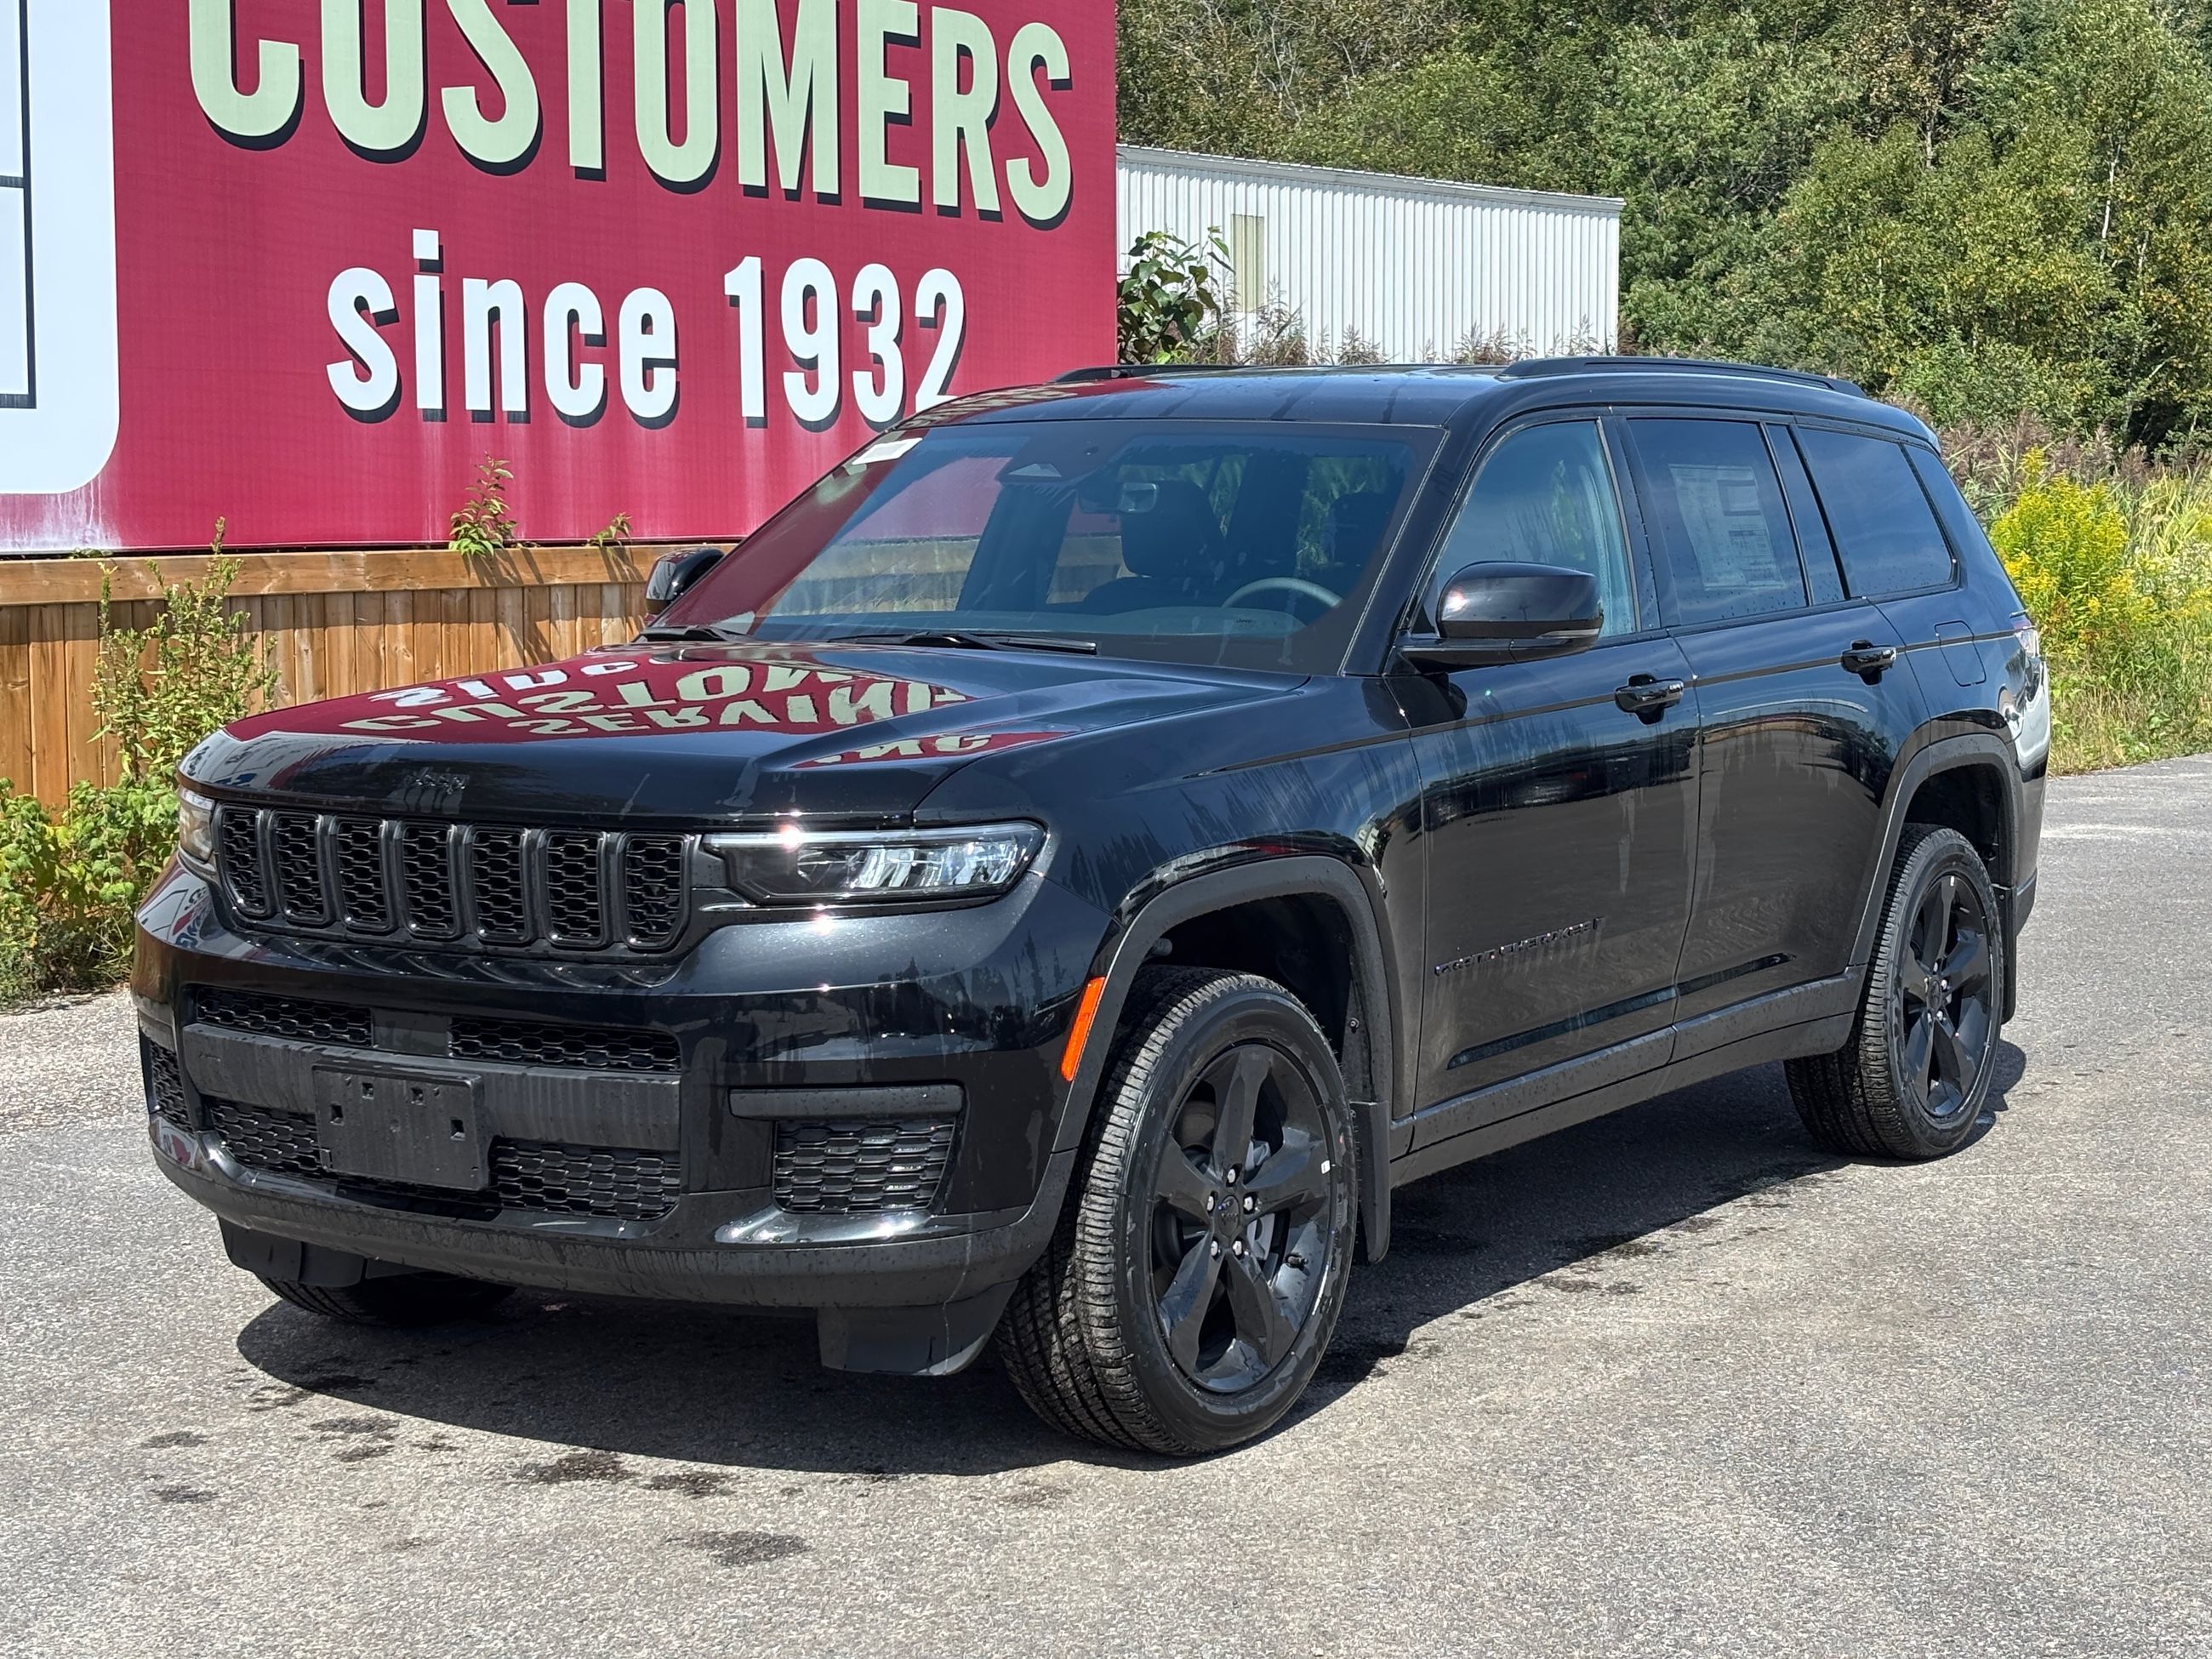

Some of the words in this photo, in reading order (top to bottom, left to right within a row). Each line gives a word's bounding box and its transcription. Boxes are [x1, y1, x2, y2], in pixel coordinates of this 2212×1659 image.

[189, 0, 1073, 228] CUSTOMERS
[326, 228, 679, 425] since
[724, 255, 966, 427] 1932
